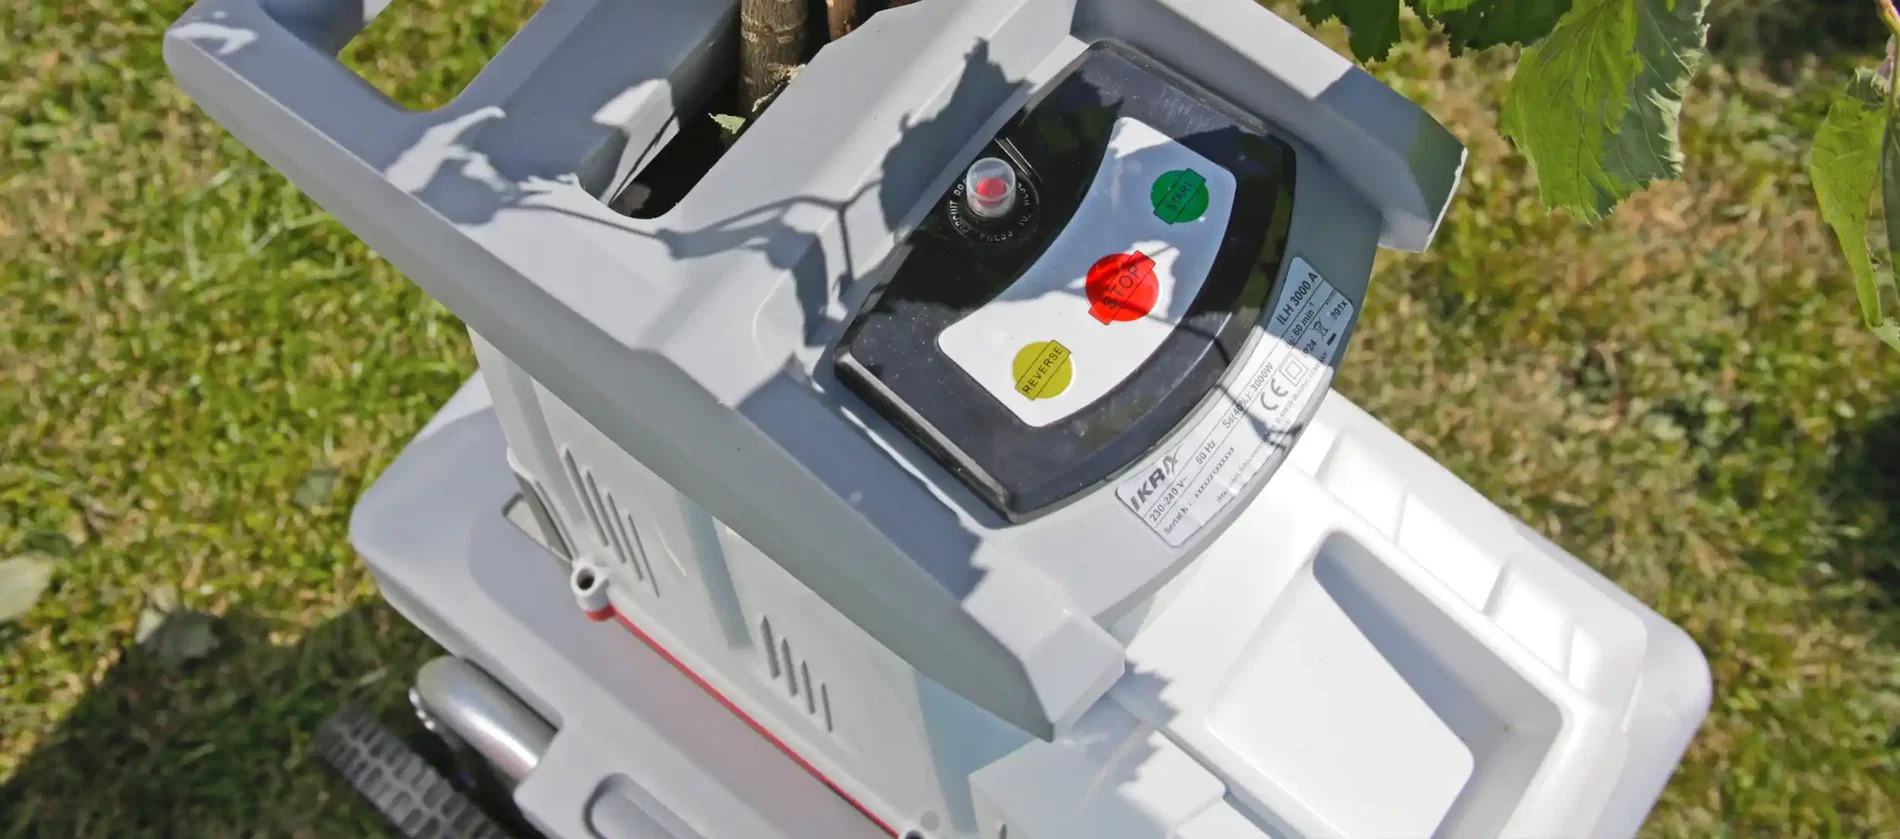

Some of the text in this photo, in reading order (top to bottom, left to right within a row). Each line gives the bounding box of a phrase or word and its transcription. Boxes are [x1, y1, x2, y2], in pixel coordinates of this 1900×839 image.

[1166, 180, 1194, 213] START
[1102, 264, 1142, 311] STOP
[1276, 272, 1319, 326] ILH 3000 A
[1293, 323, 1303, 336] 60
[1022, 345, 1064, 394] REVERSE
[1250, 362, 1273, 392] 3000W
[1130, 447, 1180, 512] IKRA
[1149, 487, 1179, 522] 230-240
[1195, 451, 1207, 465] 50
[1205, 440, 1216, 453] Hz
[1163, 512, 1183, 535] Serial
